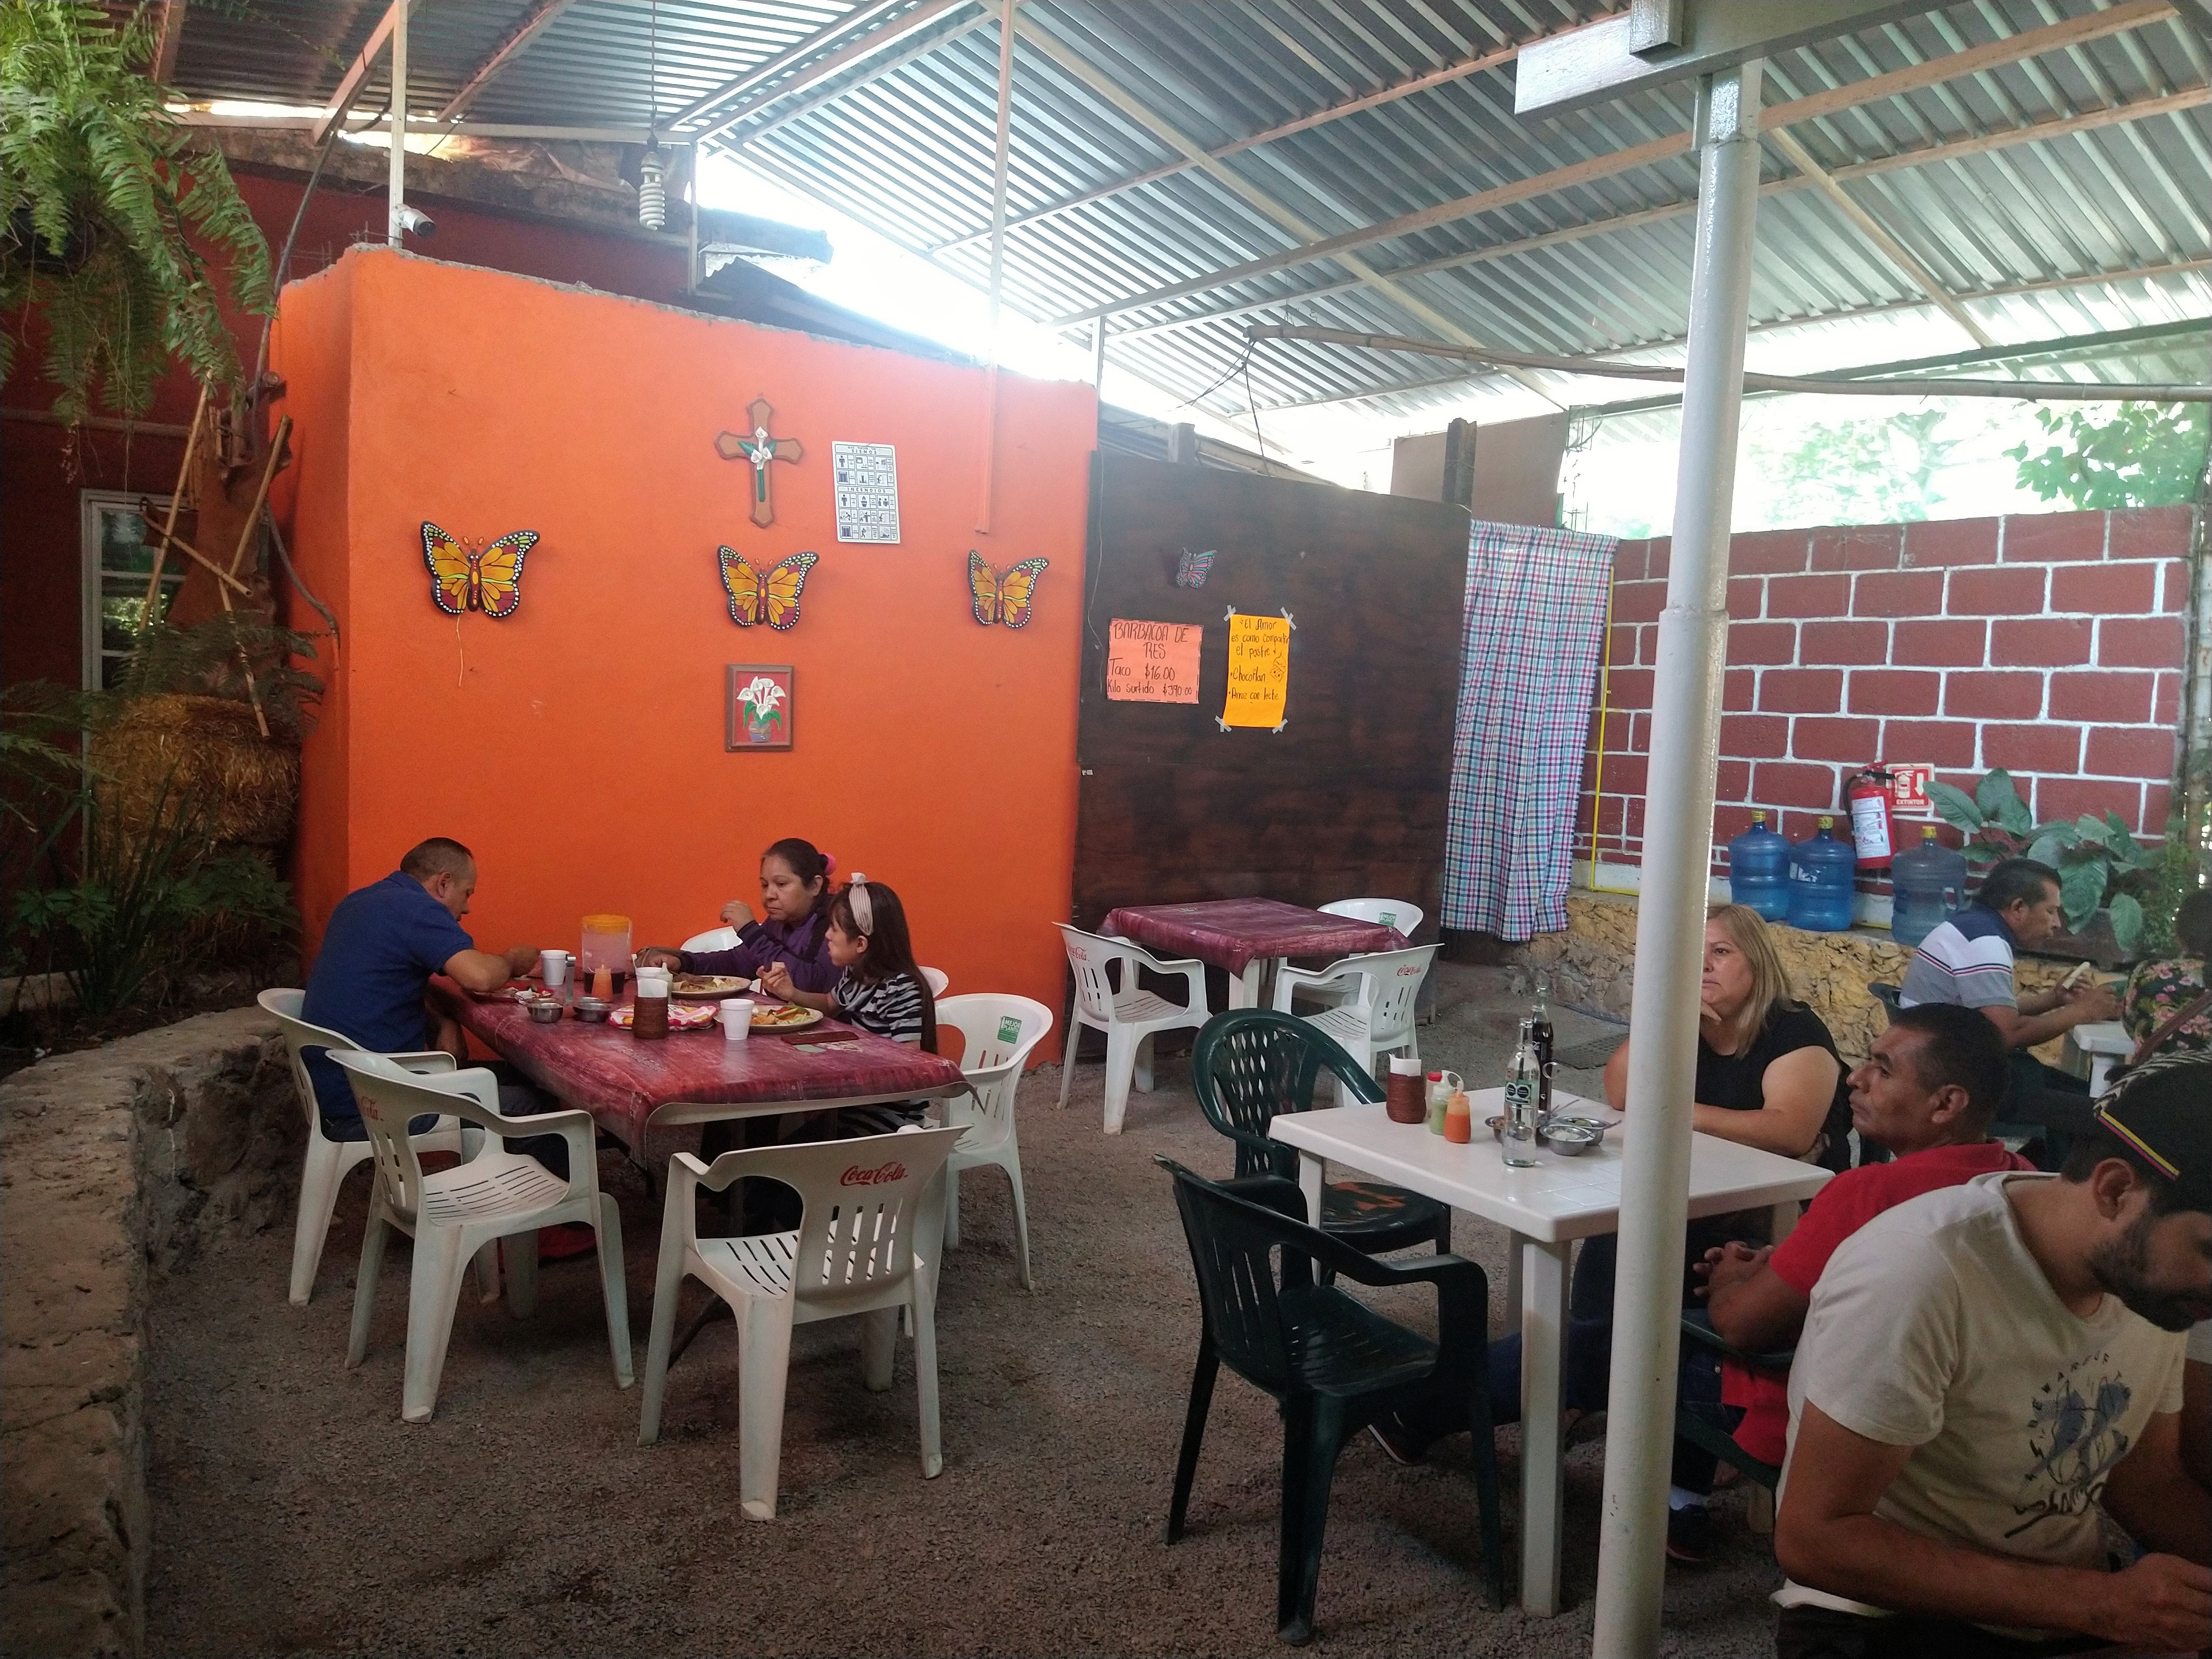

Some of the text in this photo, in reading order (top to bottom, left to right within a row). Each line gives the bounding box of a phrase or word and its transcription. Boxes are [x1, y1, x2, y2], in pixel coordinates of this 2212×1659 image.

[1114, 622, 1189, 643] BARBACOA DE
[1255, 619, 1277, 630] Amor
[1143, 641, 1166, 659] RES
[1236, 643, 1270, 659] el postre
[1109, 658, 1131, 676] Taco
[1233, 665, 1265, 682] Chocoflan
[1108, 679, 1121, 693] Kilo
[1162, 683, 1192, 696] $390.00
[1232, 687, 1279, 700] Arroz con leche
